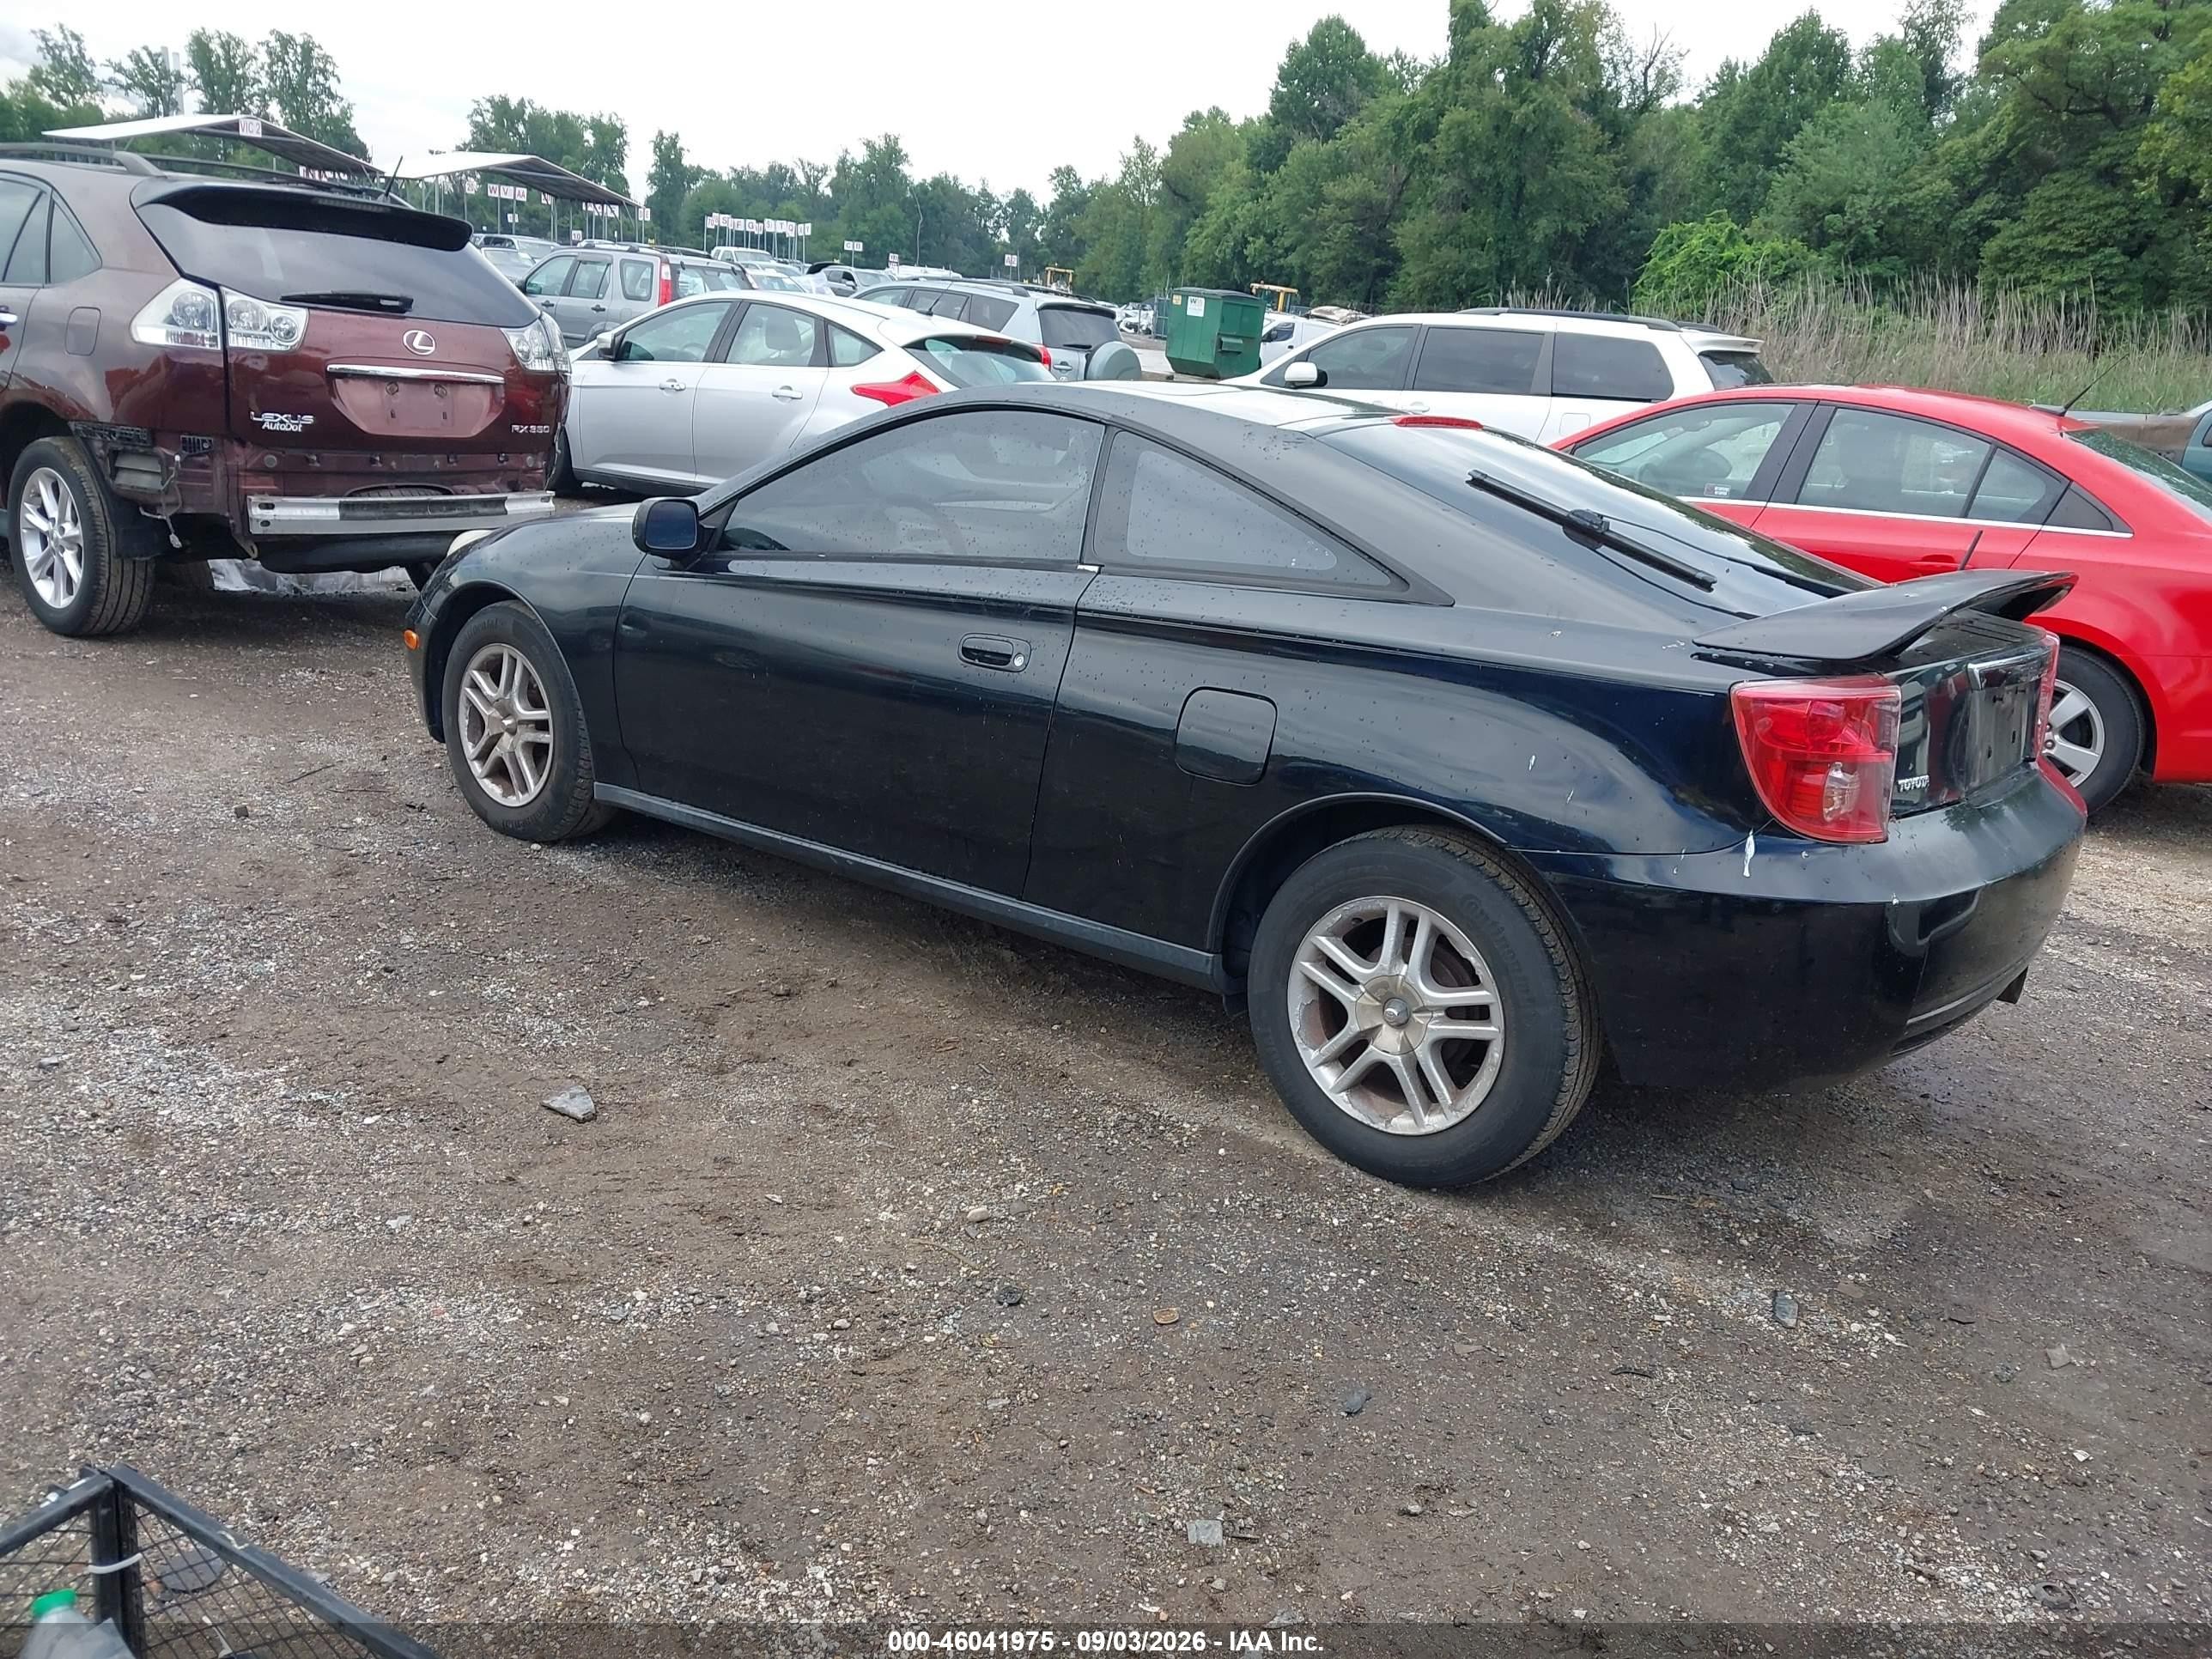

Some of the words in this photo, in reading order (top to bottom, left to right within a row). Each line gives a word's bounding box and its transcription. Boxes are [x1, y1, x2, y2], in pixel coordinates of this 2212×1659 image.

[255, 122, 261, 135] 2
[489, 185, 498, 194] W
[502, 186, 509, 196] V
[516, 189, 526, 198] AA
[721, 216, 728, 225] S
[249, 410, 314, 424] LEXUS
[261, 421, 303, 432] AutoDot
[511, 424, 528, 433] RX
